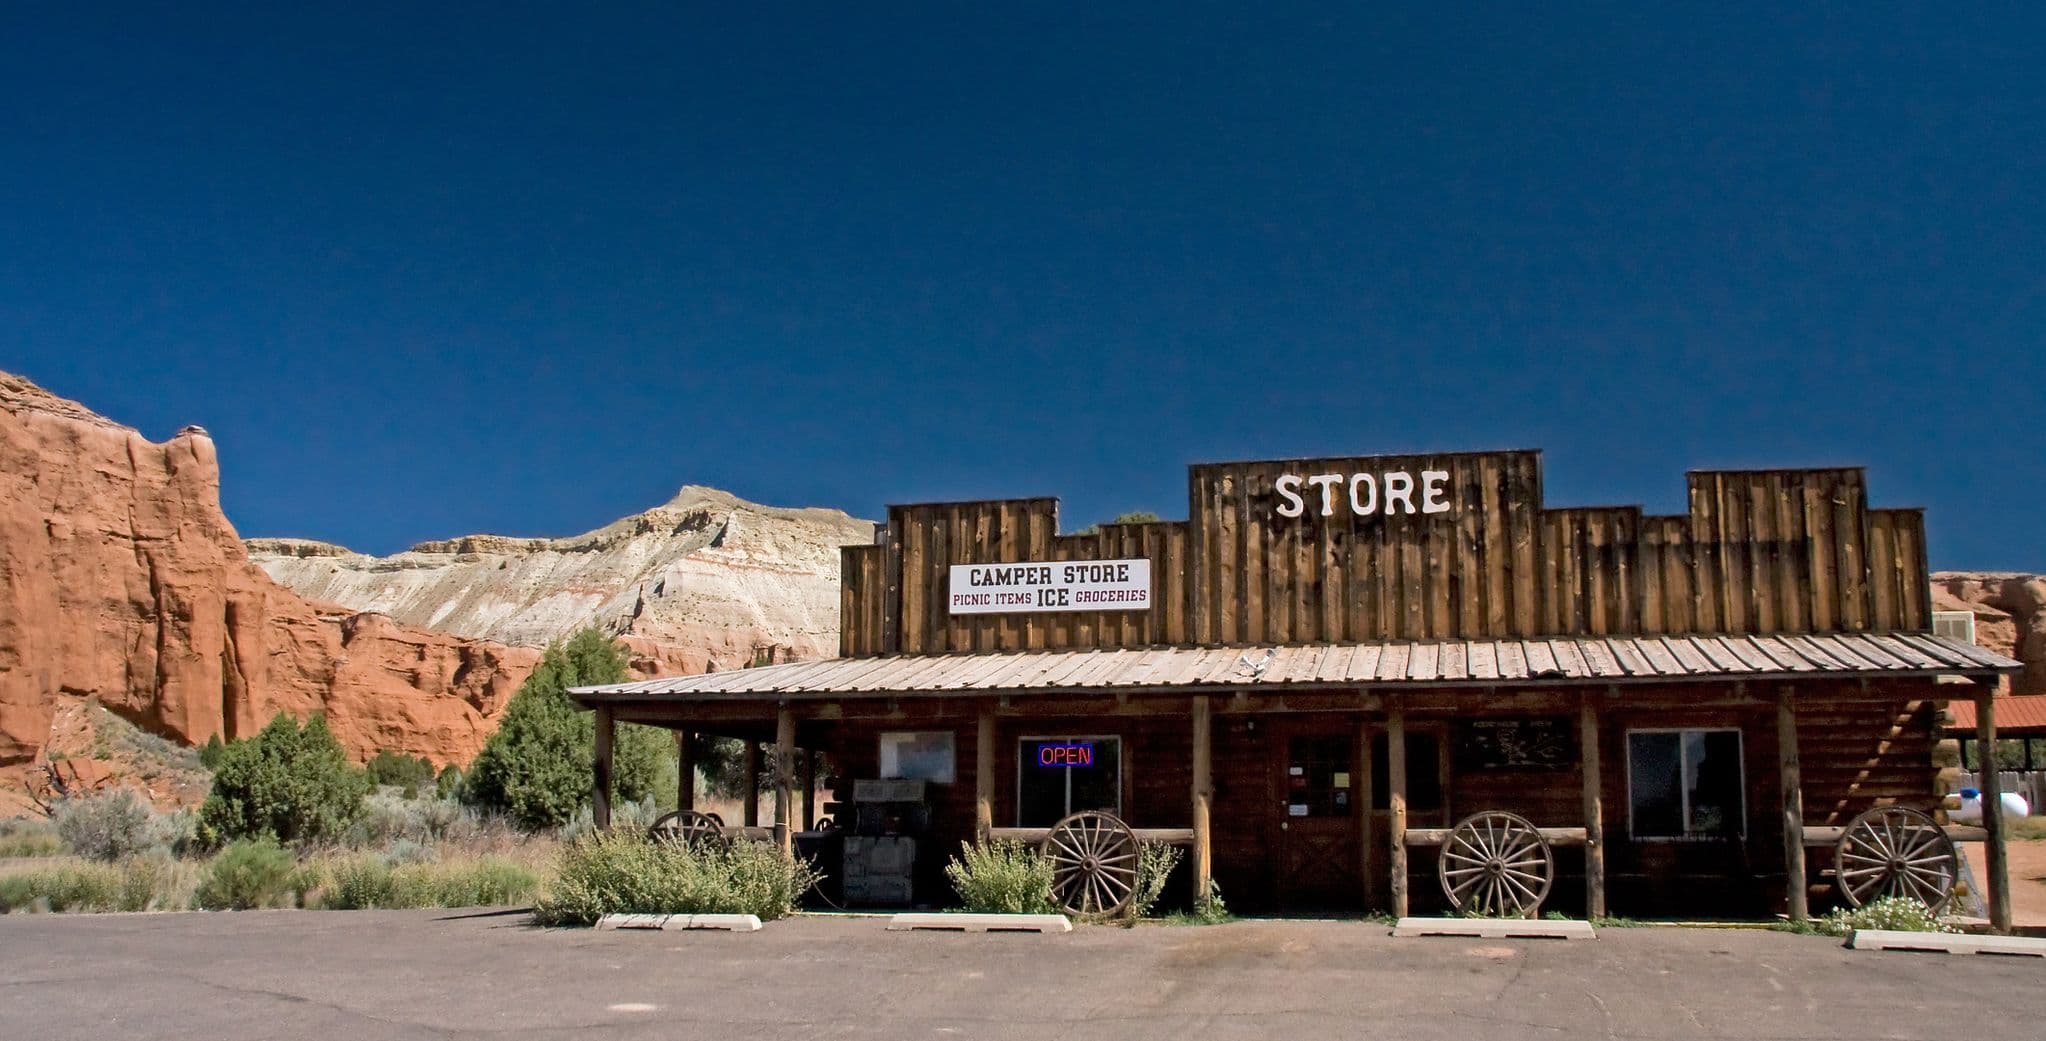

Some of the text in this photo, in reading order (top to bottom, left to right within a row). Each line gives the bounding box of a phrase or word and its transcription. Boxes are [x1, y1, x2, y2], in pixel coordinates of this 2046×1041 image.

[1275, 470, 1451, 517] STORE
[970, 564, 1129, 586] CAMPER STORE
[953, 588, 1147, 607] PICNIC ITEMS ICE GROCERIES
[1041, 747, 1090, 765] OPEN
